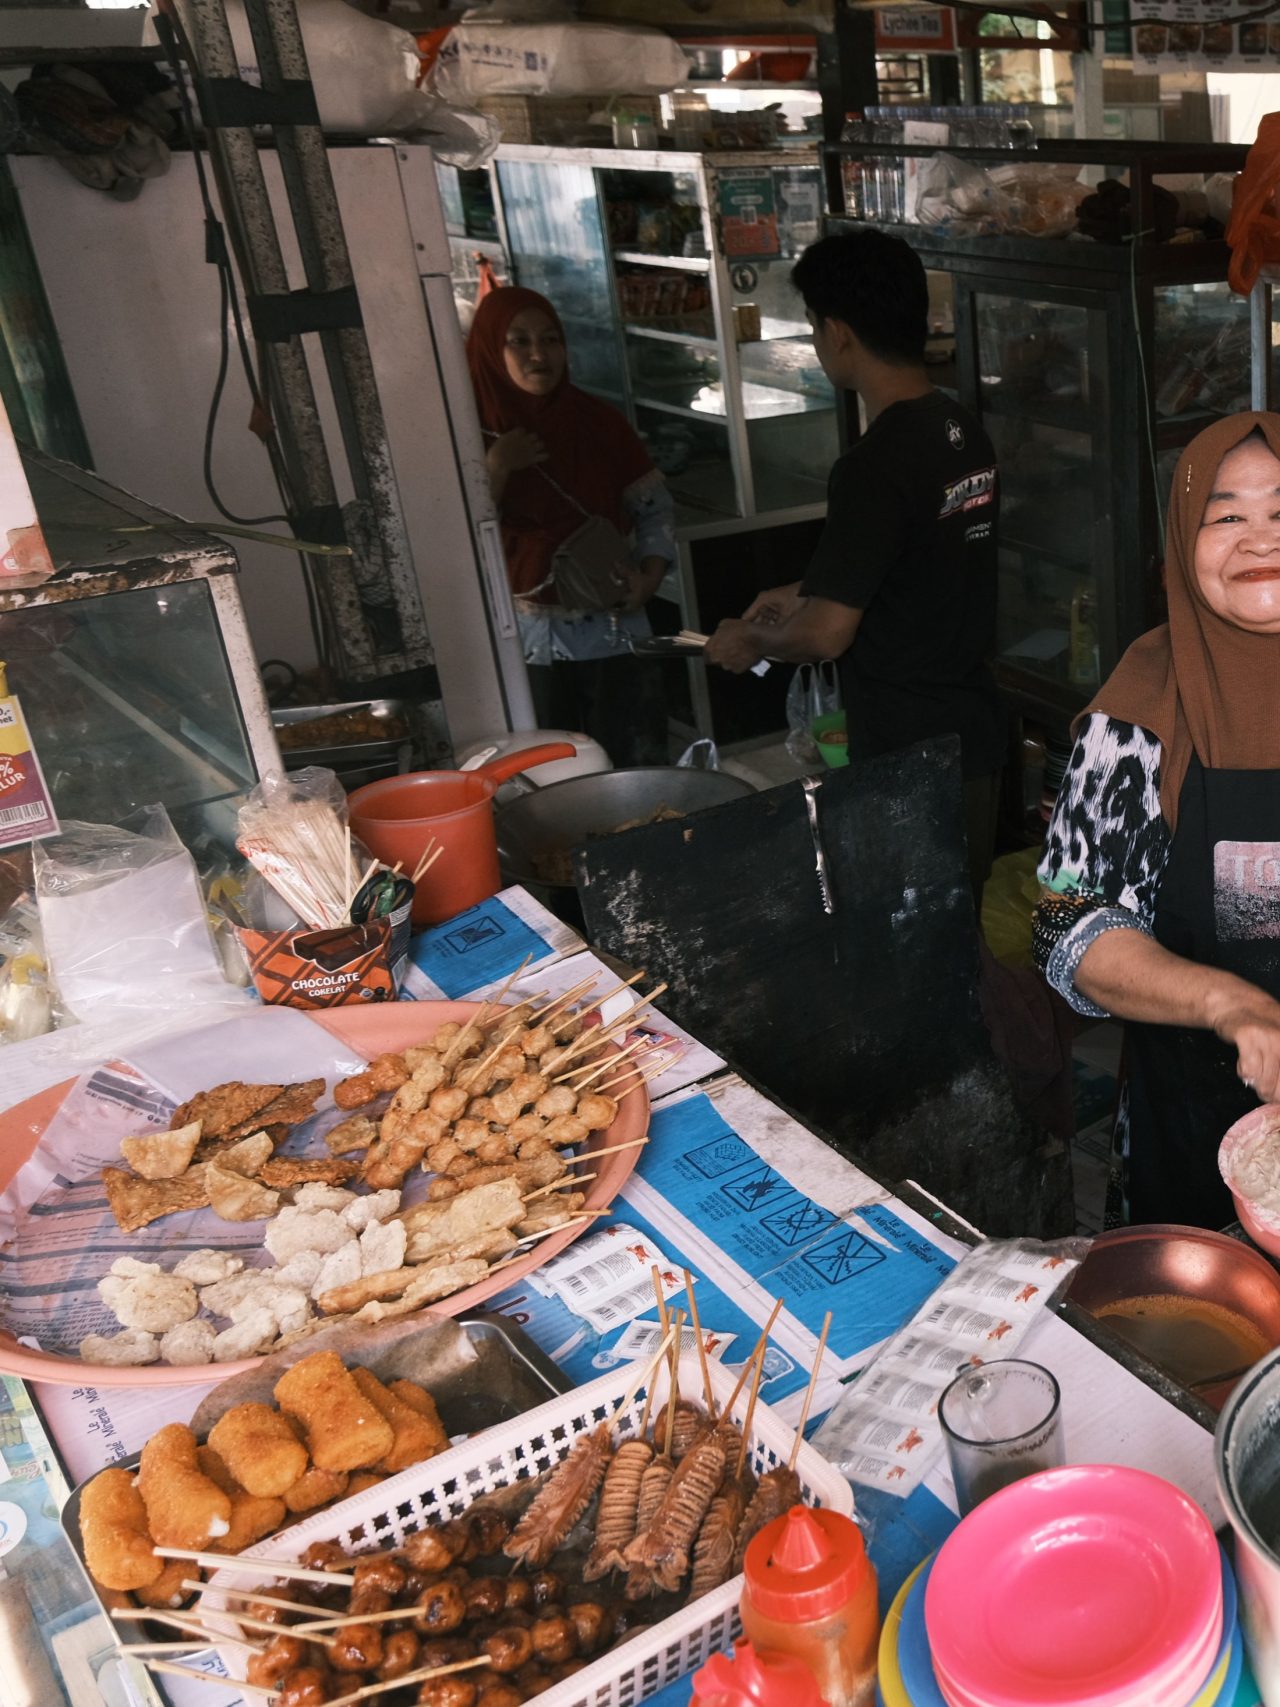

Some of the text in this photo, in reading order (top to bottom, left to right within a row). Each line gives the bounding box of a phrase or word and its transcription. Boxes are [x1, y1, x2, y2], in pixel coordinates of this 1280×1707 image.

[882, 14, 919, 35] Lychee
[0, 771, 27, 793] LUR
[291, 972, 361, 990] CHOCOLATE
[308, 985, 347, 998] COKELAT
